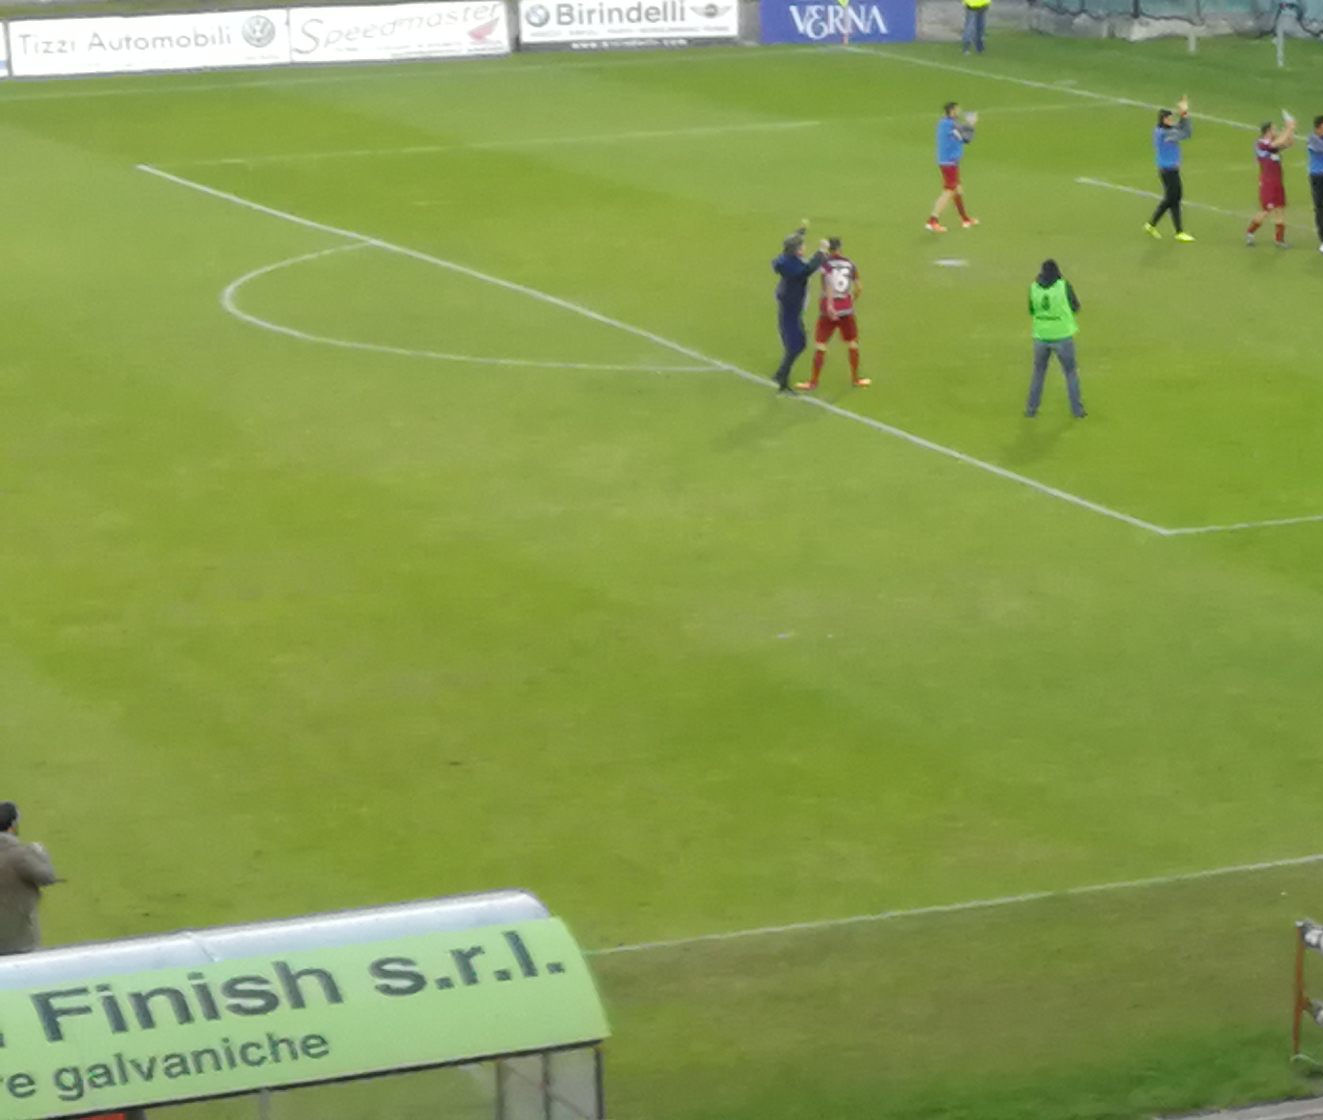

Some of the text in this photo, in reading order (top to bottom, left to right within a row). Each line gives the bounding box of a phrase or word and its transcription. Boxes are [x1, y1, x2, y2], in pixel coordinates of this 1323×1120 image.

[294, 3, 499, 55] Speedmaster
[556, 0, 686, 26] Birindelli
[790, 4, 889, 39] VERNA
[18, 34, 76, 56] Tizzi
[87, 26, 233, 52] Automobili
[31, 930, 567, 1044] Finish s.r.l.
[52, 1032, 331, 1102] galvaniche
